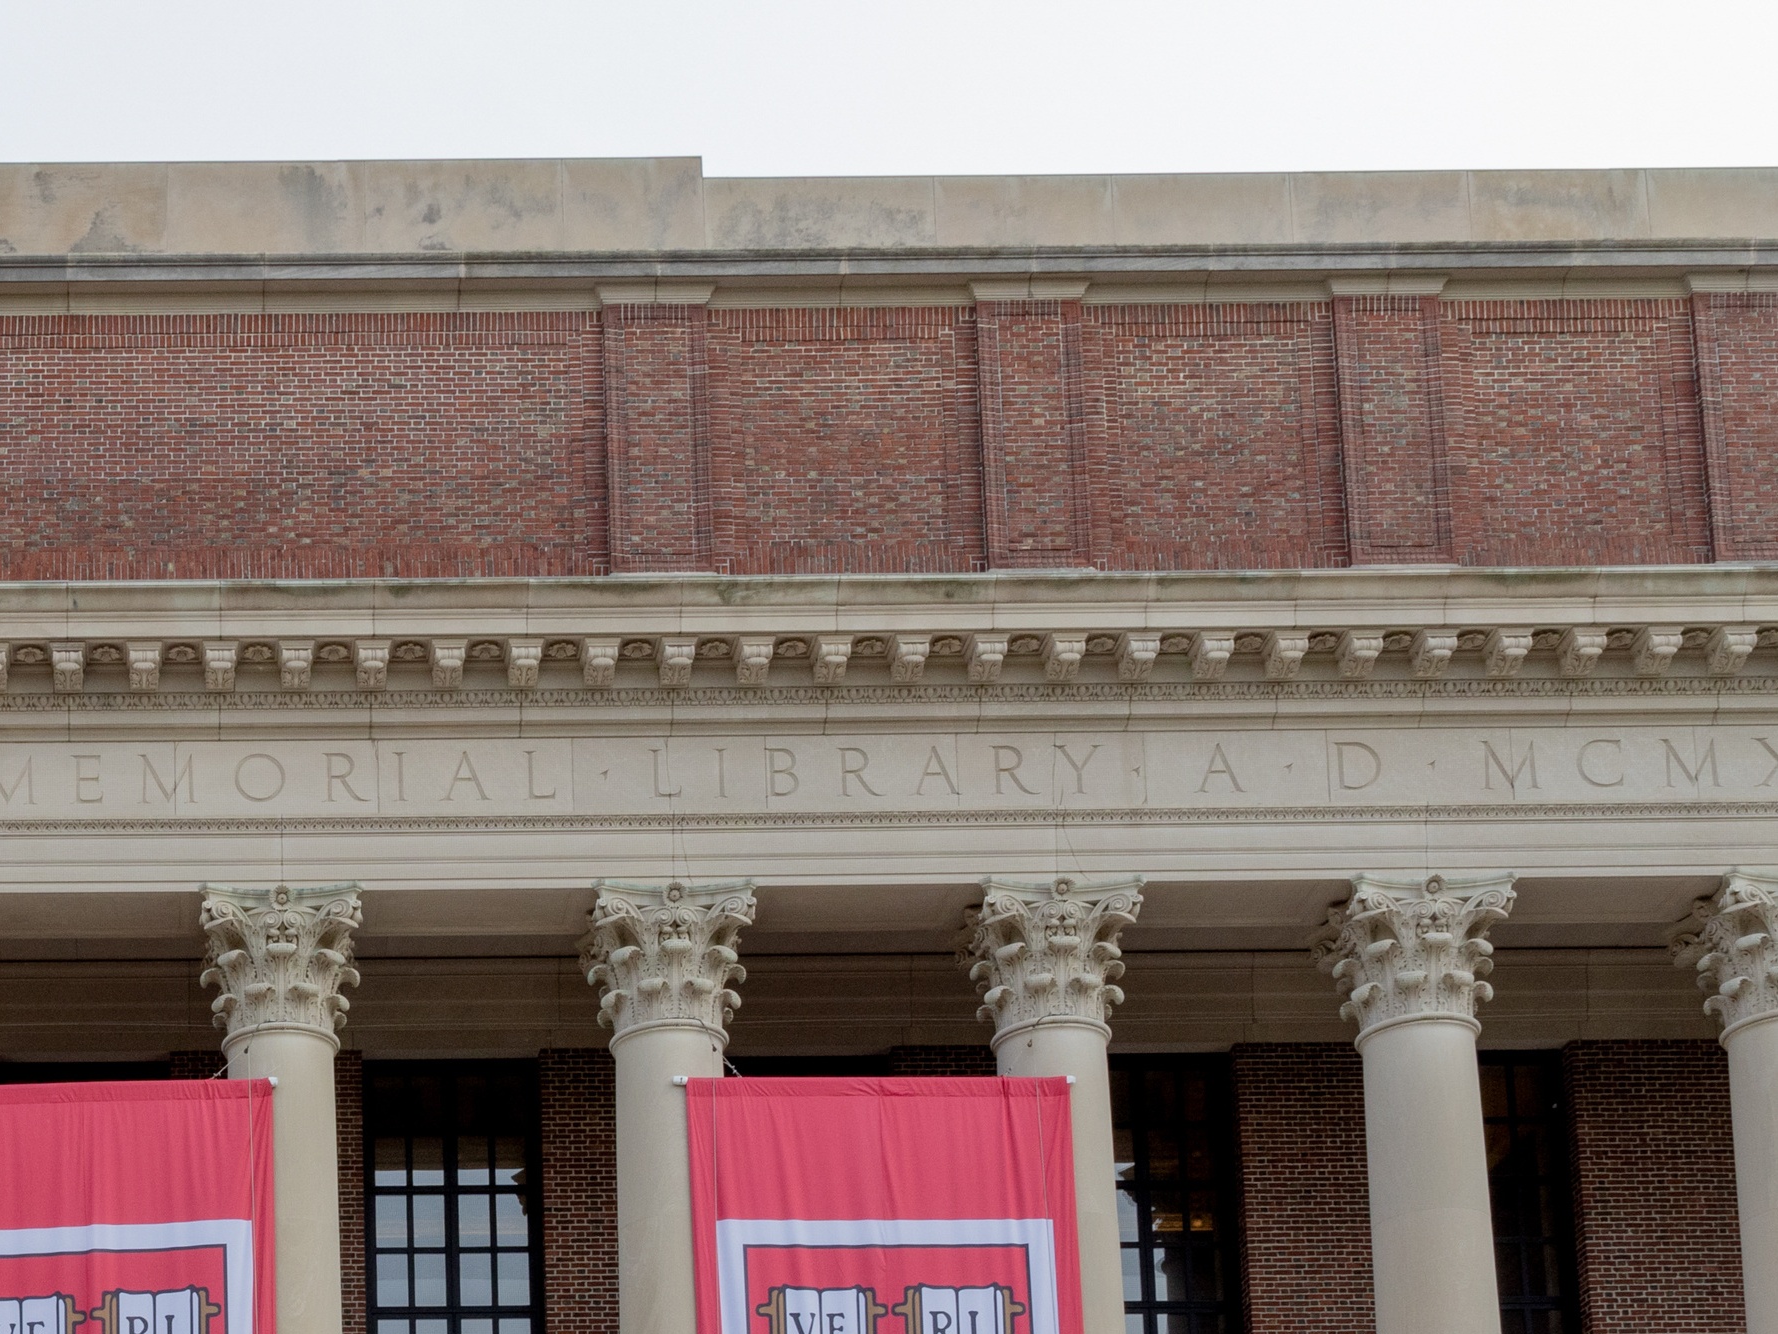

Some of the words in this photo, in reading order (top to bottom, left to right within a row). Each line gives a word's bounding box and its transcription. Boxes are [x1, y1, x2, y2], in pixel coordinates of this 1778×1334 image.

[647, 743, 1104, 800] LIBRARY
[1194, 741, 1246, 794] A
[1334, 740, 1384, 791] D
